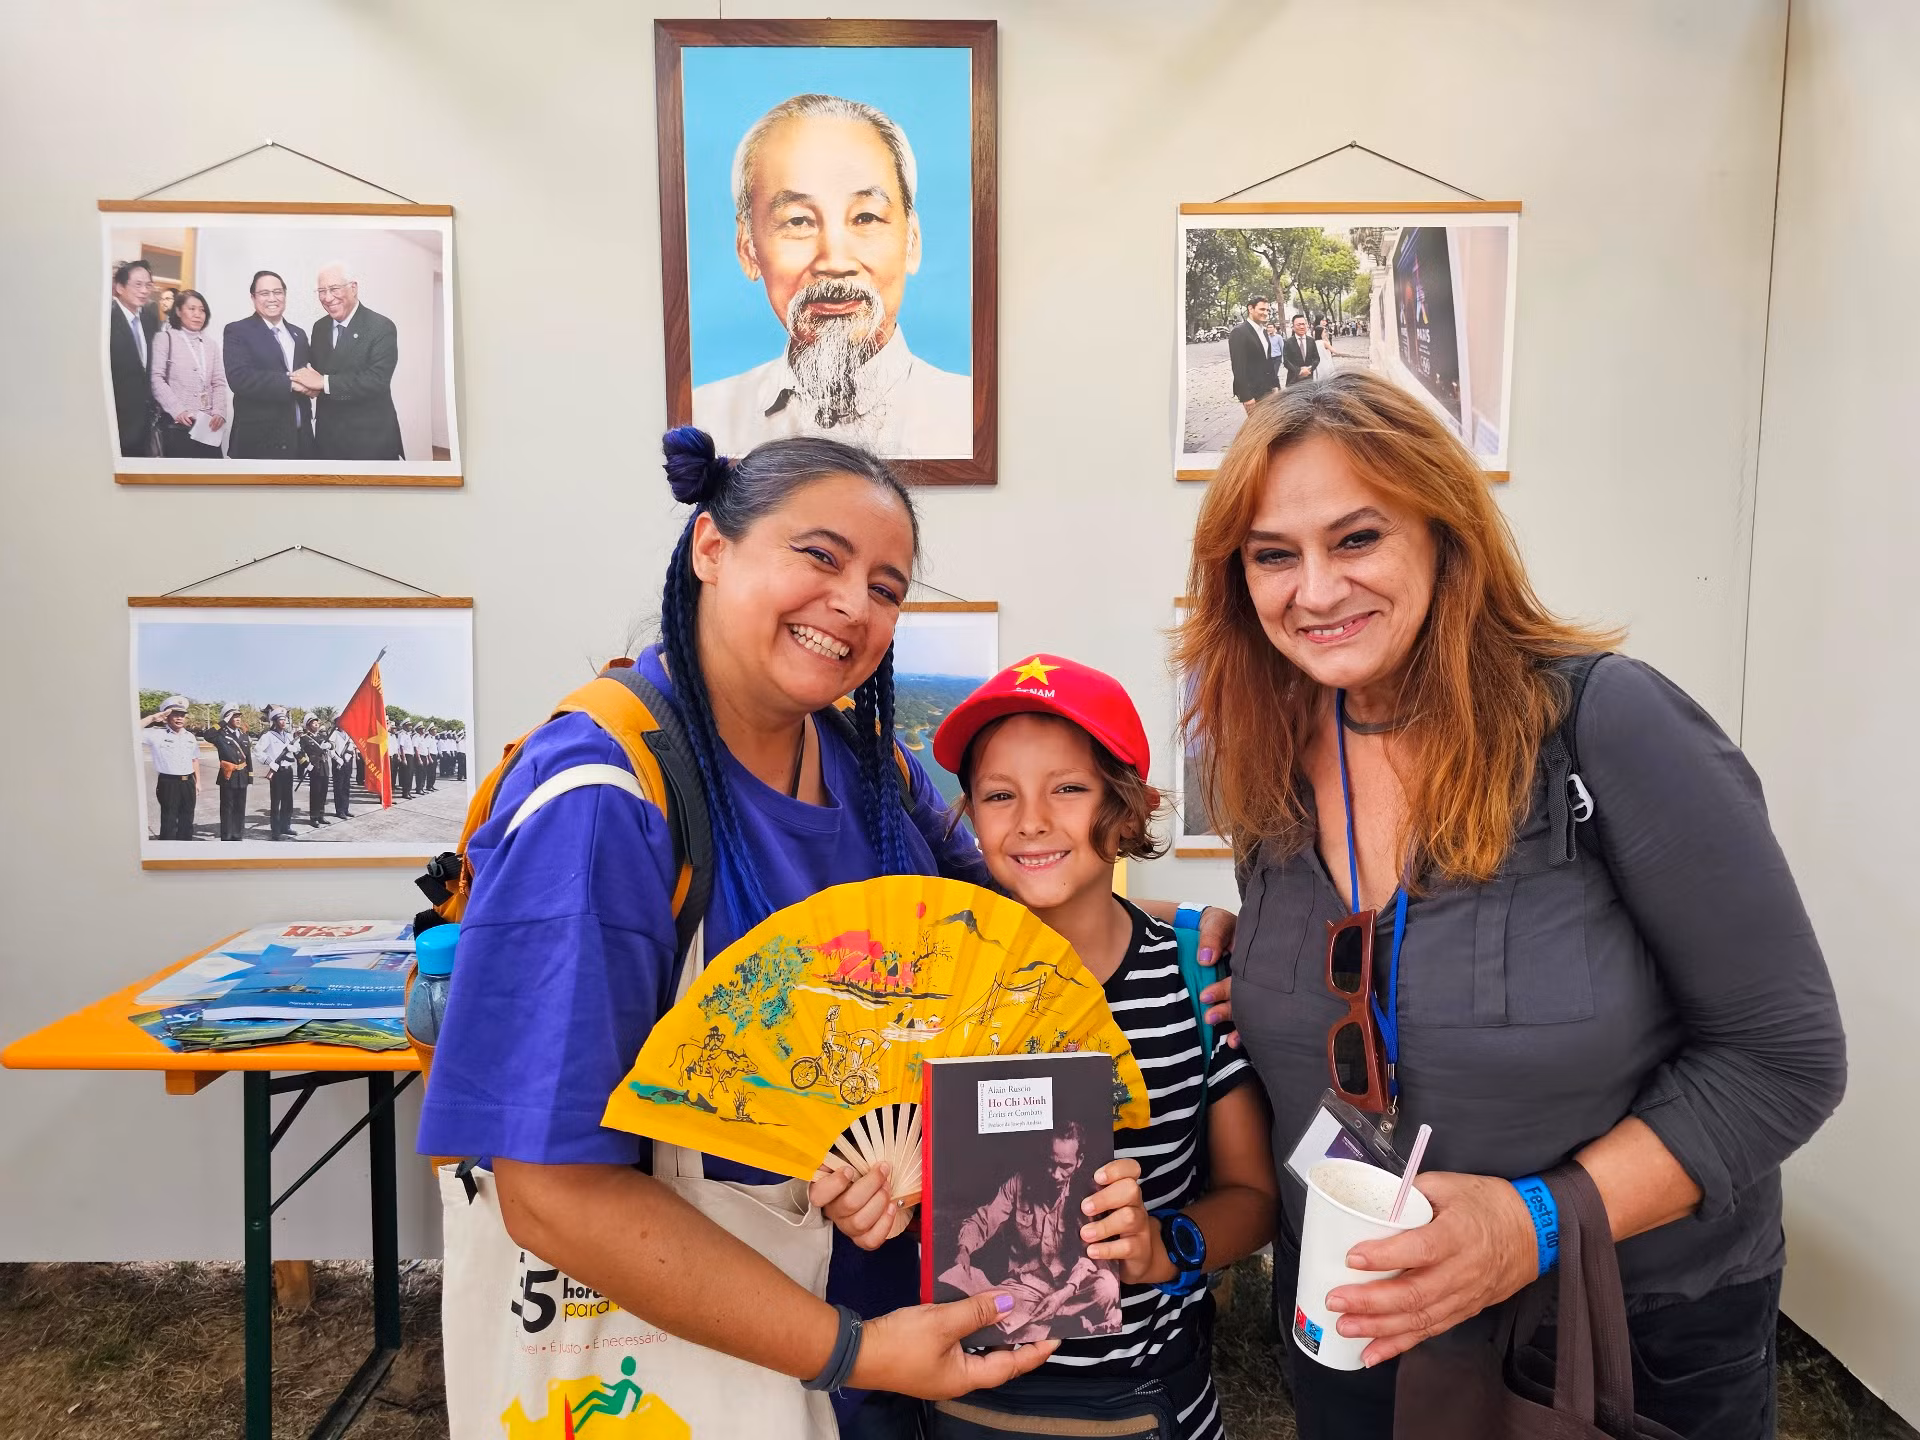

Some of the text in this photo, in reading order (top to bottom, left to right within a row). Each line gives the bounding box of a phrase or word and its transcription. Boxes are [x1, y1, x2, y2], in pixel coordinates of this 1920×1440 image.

[988, 1085, 1031, 1094] Alain Ruscio
[988, 1095, 1046, 1108] Ho Chi Minh
[1014, 1108, 1043, 1117] Combats
[1524, 1185, 1553, 1229] Festa
[564, 1299, 610, 1323] para
[558, 1342, 582, 1355] justo
[593, 1336, 599, 1350] É
[602, 1331, 668, 1348] necessário
